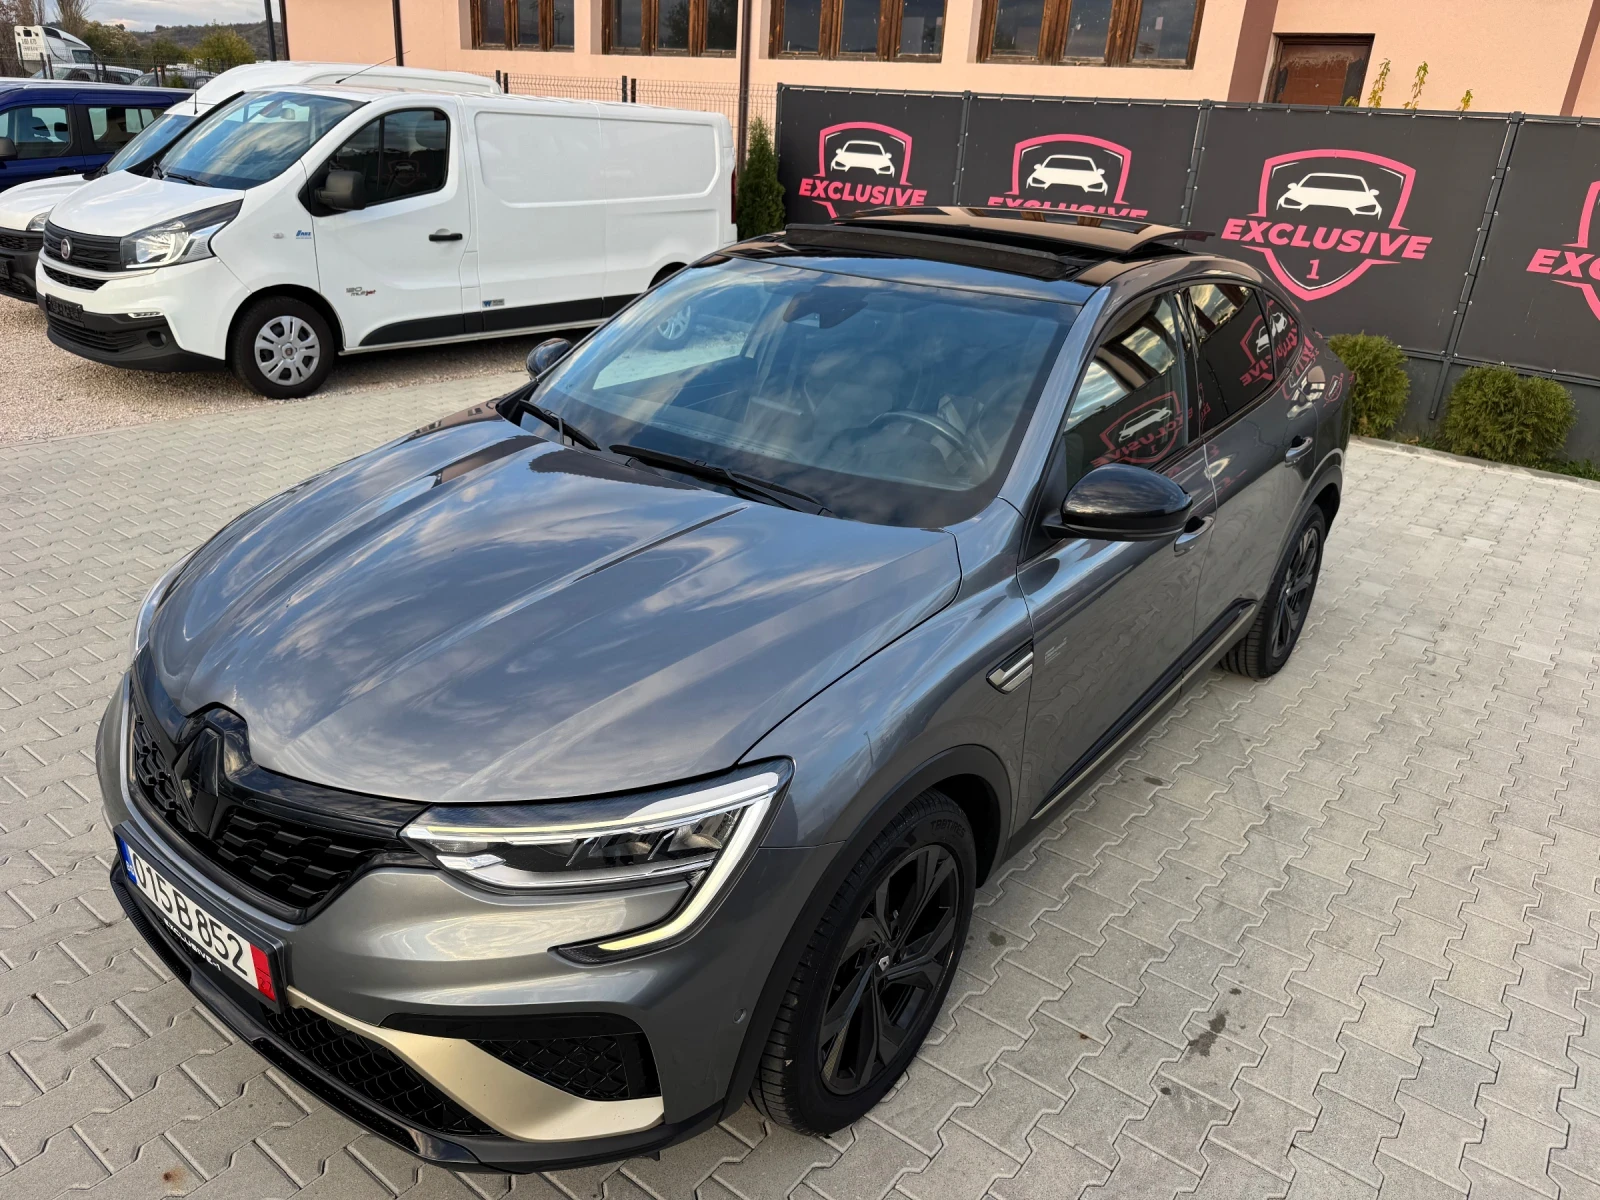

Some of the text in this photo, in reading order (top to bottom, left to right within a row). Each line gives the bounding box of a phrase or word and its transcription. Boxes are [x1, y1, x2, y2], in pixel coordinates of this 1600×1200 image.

[799, 178, 927, 206] EXCLUSIVE
[1220, 218, 1433, 260] EXCLUSIVE
[1306, 259, 1320, 280] 1
